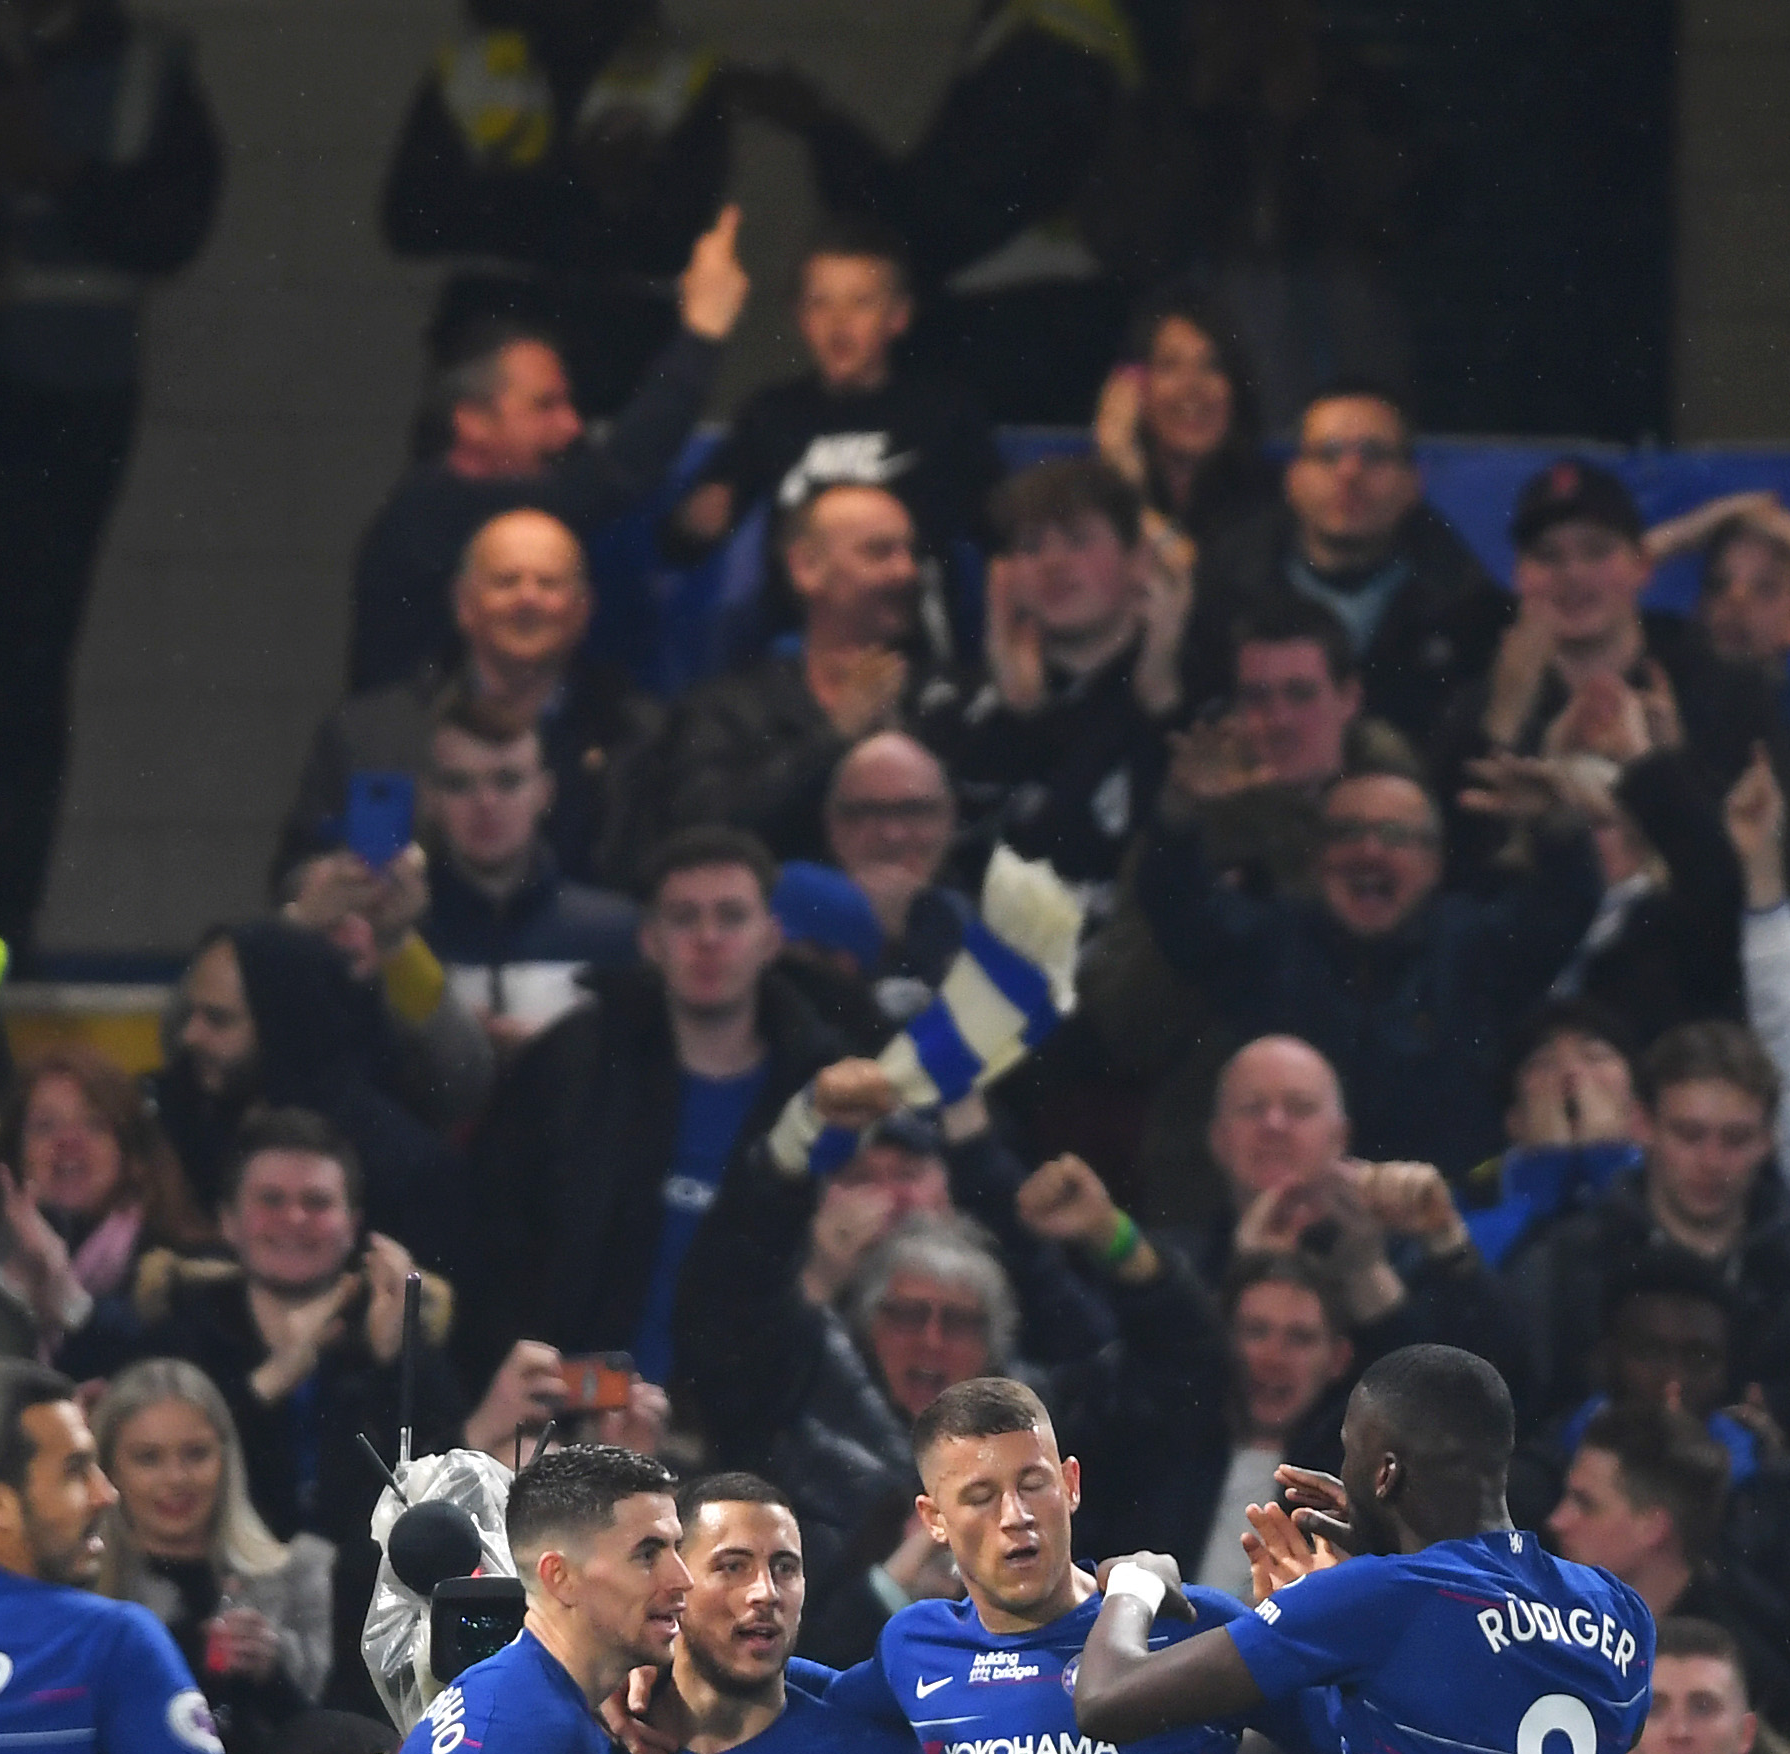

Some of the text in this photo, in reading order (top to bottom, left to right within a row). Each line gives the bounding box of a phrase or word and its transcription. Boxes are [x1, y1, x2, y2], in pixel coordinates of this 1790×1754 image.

[1477, 1592, 1636, 1679] RÜDIGER
[974, 1651, 1019, 1669] building
[992, 1665, 1039, 1681] bridges
